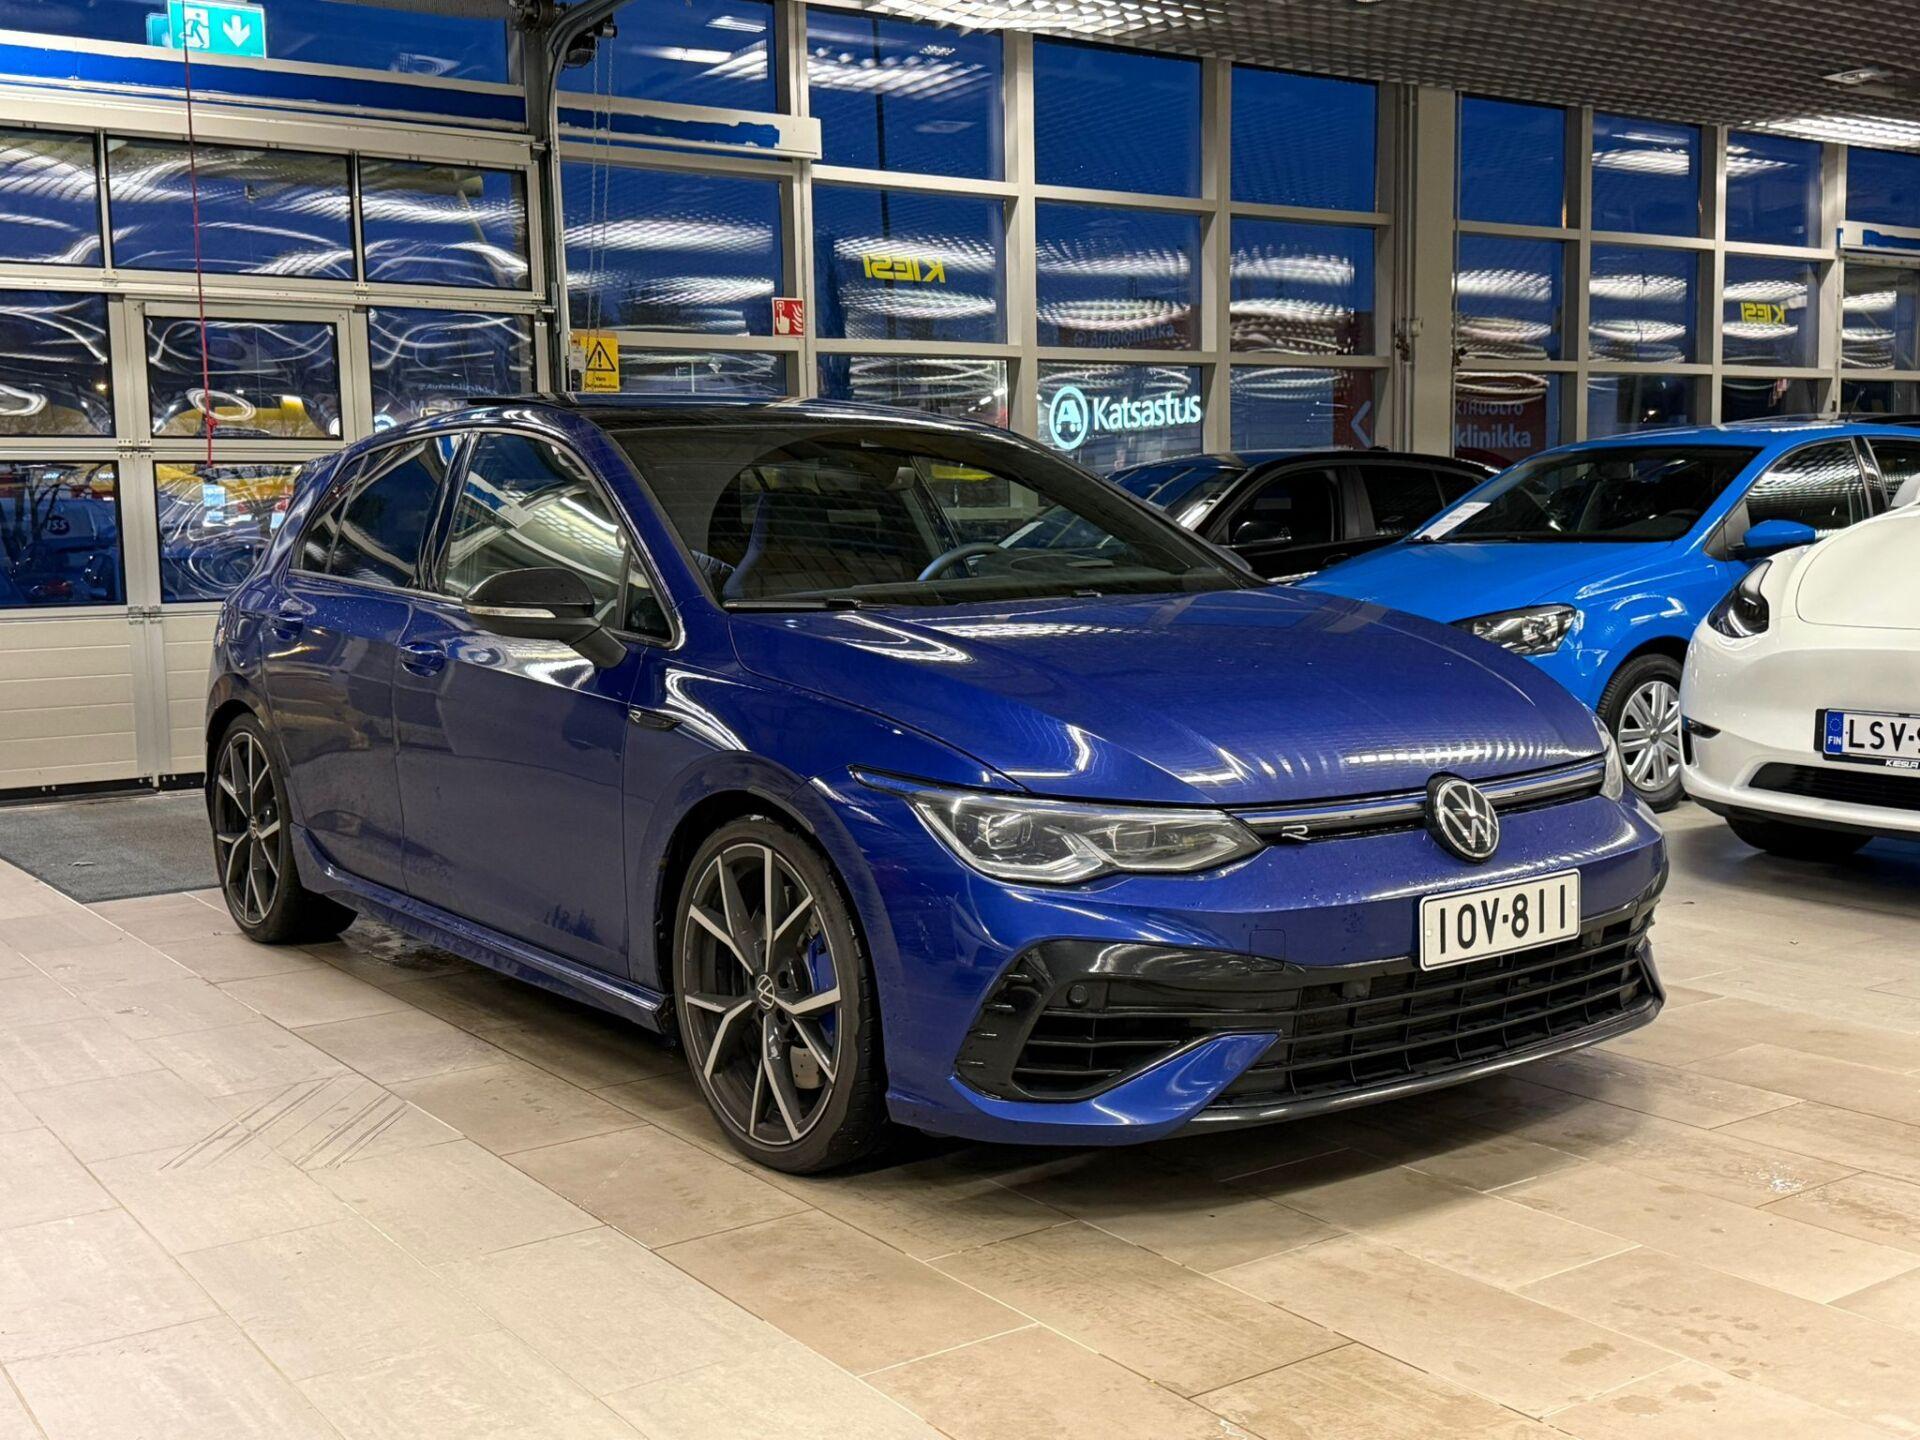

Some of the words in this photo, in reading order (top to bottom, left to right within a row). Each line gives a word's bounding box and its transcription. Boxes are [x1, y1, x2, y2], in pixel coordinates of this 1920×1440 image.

[1093, 391, 1202, 431] Katsastus
[1827, 735, 1842, 745] FIN
[1848, 719, 1920, 753] LSV-
